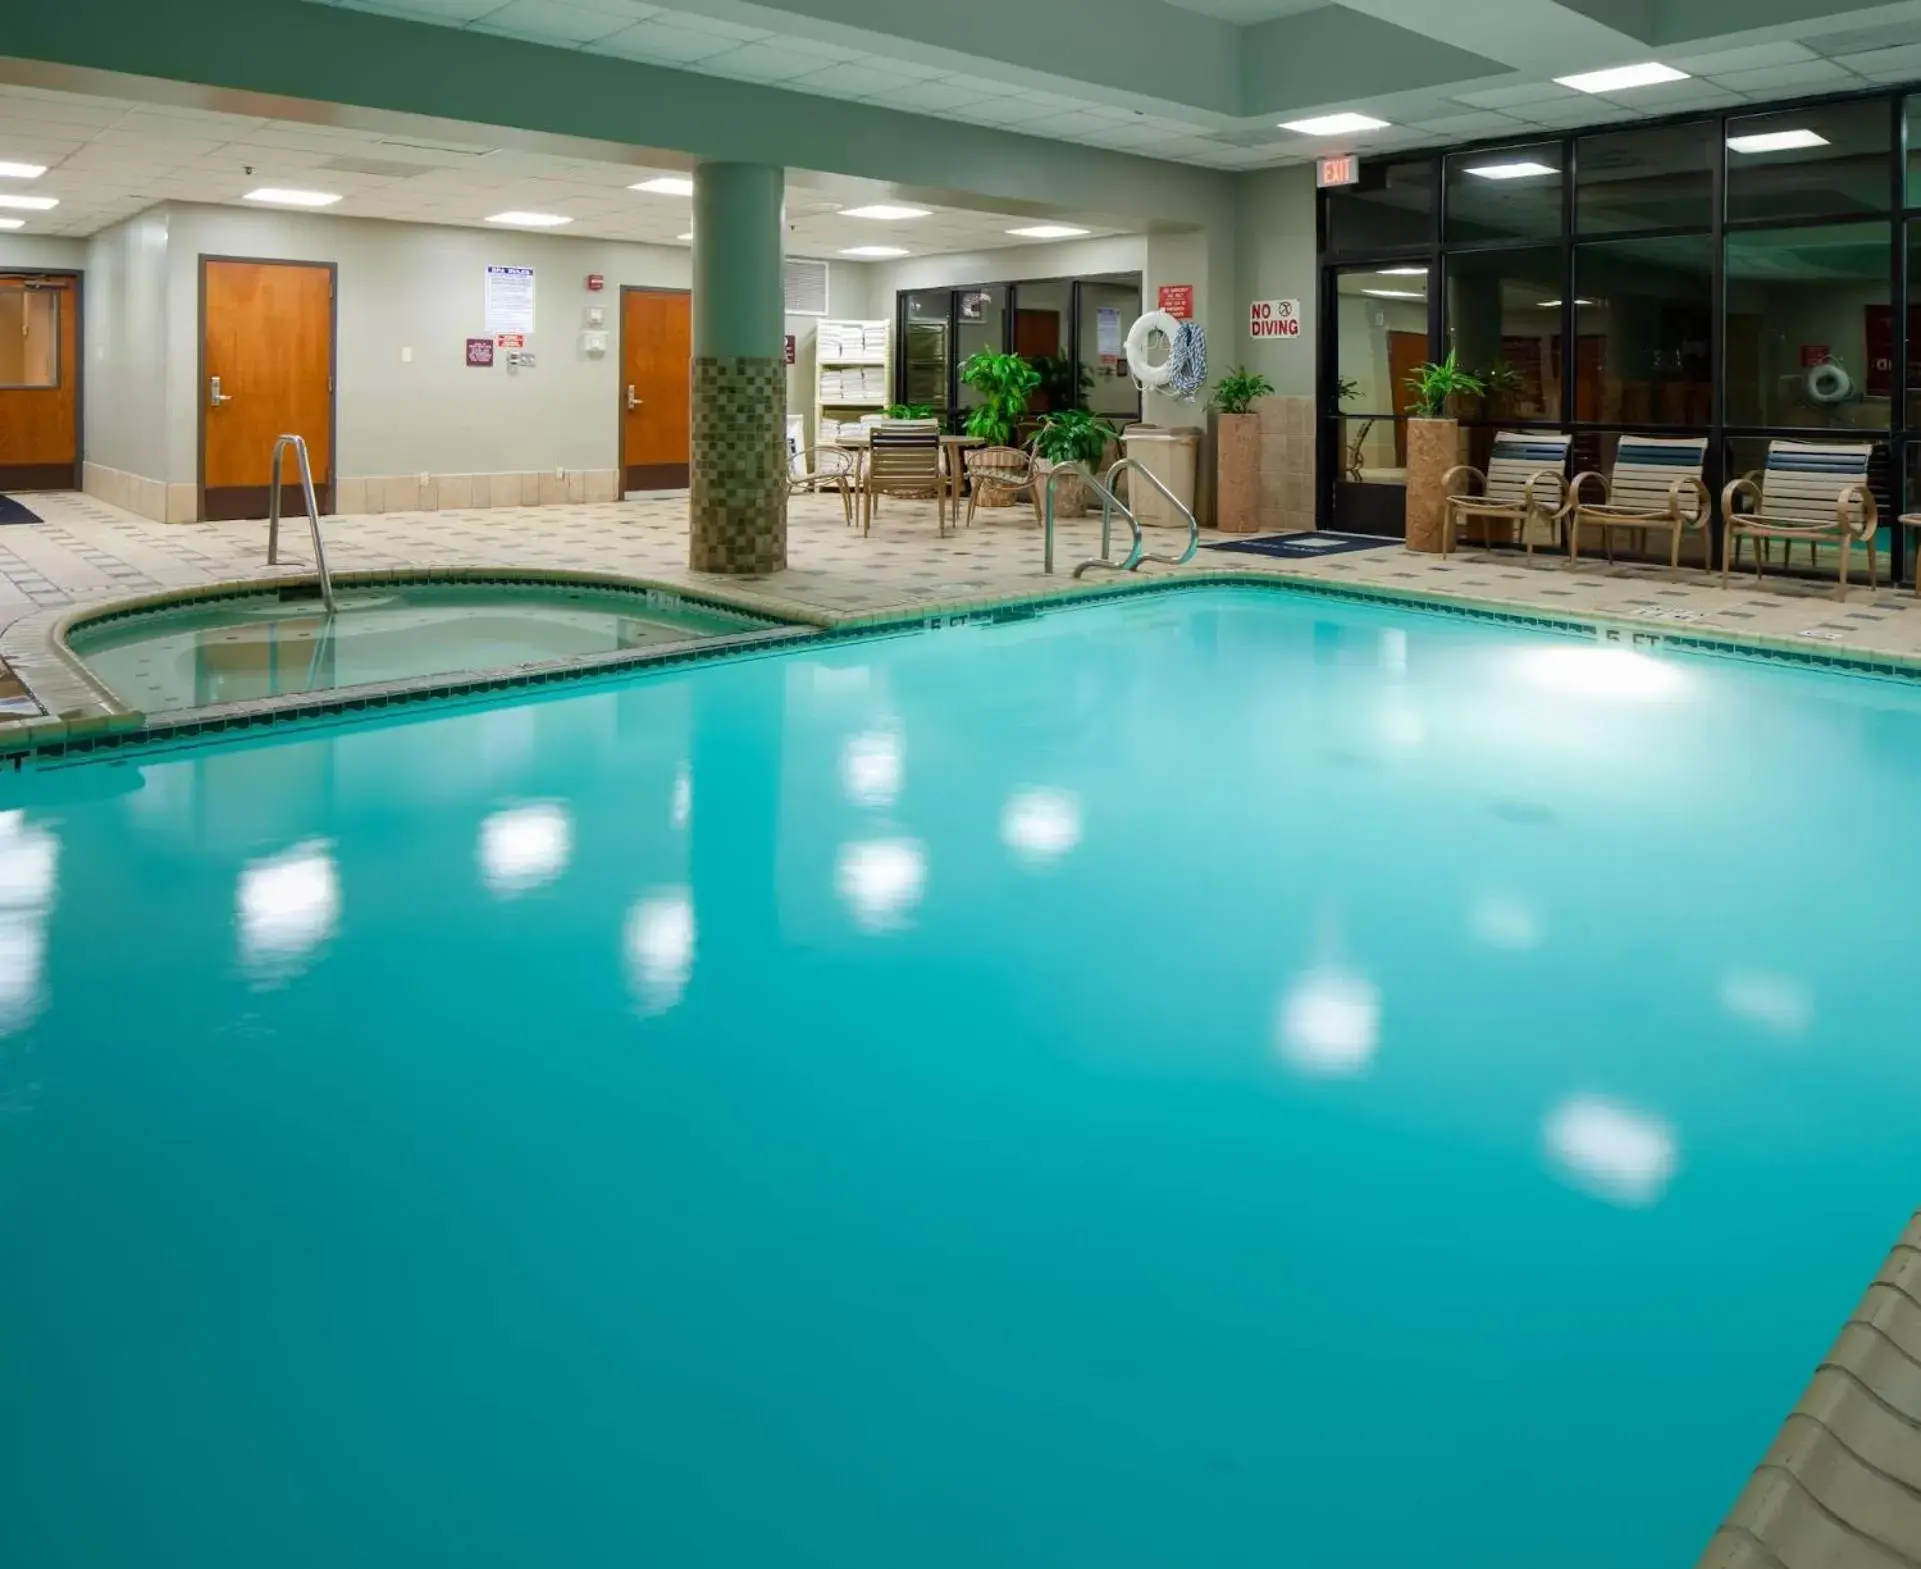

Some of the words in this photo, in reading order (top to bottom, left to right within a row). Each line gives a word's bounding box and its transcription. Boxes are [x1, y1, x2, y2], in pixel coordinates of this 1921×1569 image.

[1252, 303, 1271, 319] NO
[1252, 319, 1298, 336] DIVING
[1632, 633, 1660, 647] FT
